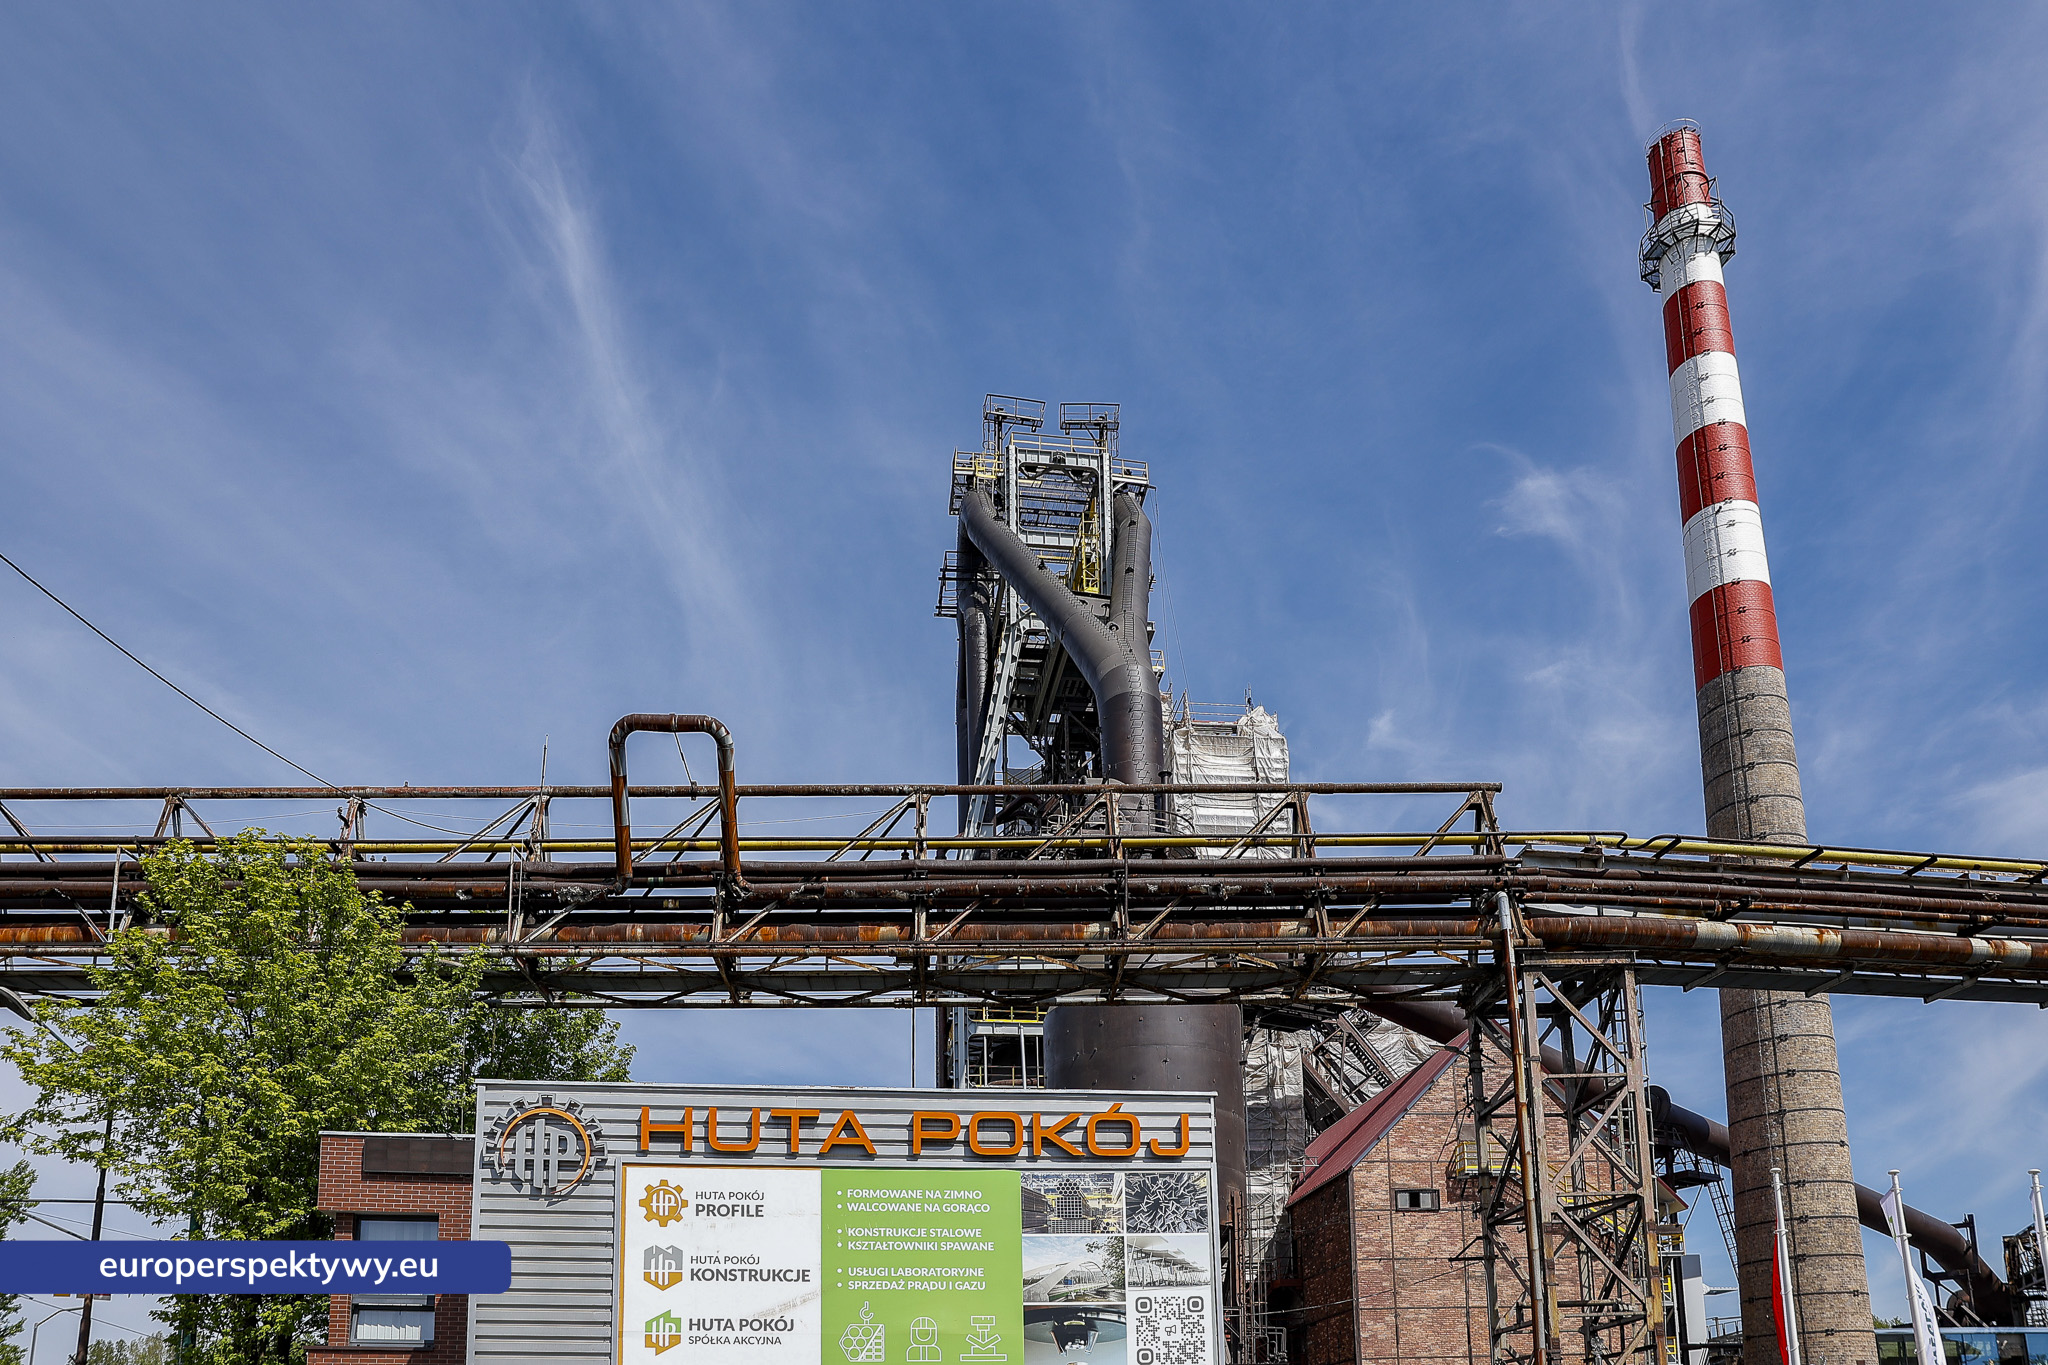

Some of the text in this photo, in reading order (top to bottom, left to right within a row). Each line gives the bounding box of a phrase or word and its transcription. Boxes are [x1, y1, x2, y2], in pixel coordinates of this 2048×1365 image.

[639, 1102, 1191, 1157] HUTA POKÓJ
[695, 1189, 765, 1201] HUTA POKÓJ
[846, 1188, 983, 1200] FORMOWANE NA ZIMNO
[695, 1203, 765, 1218] PROFILE
[846, 1202, 991, 1215] WALCOWANE NA GORĄCO
[847, 1227, 983, 1238] KONSTRUKCJE STALOWE
[847, 1240, 995, 1251] KSZTAŁTOWNIKI SPAWANE
[690, 1253, 760, 1265] HUTA POKÓJ
[690, 1268, 811, 1283] KONSTRUKCJE
[847, 1266, 985, 1277] USŁUGI LABORATORYJNE
[847, 1278, 986, 1292] SPRZEDAŻ PRĄDU I GAZU
[688, 1315, 795, 1332] HUTA POKÓJ
[688, 1333, 783, 1346] SPÓŁKA AKCYJNA
